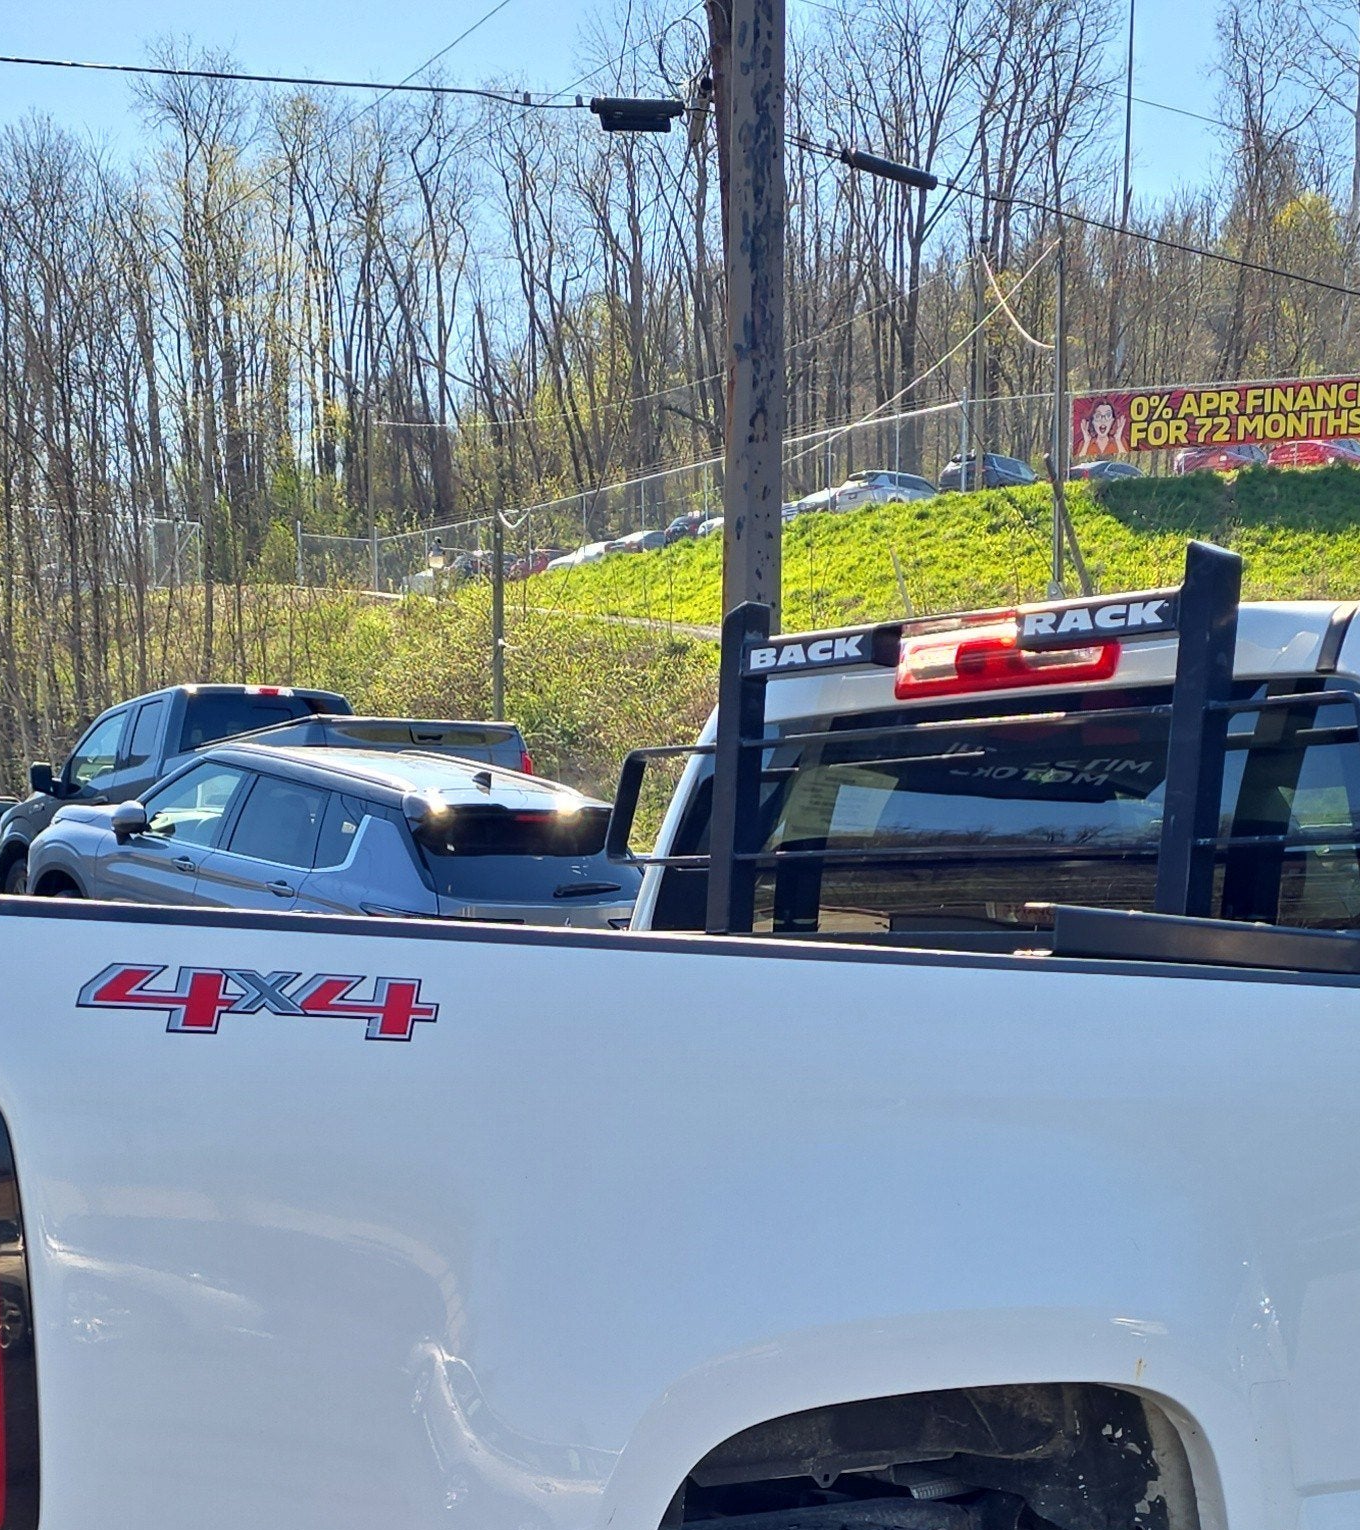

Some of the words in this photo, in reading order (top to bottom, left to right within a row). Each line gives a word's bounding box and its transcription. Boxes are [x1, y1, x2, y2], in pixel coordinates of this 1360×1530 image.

[1130, 394, 1173, 421] 0%
[1178, 390, 1240, 419] APR
[1130, 418, 1189, 448] FOR
[1195, 415, 1232, 443] 72
[749, 634, 864, 670] BACK
[1023, 600, 1166, 636] RACK
